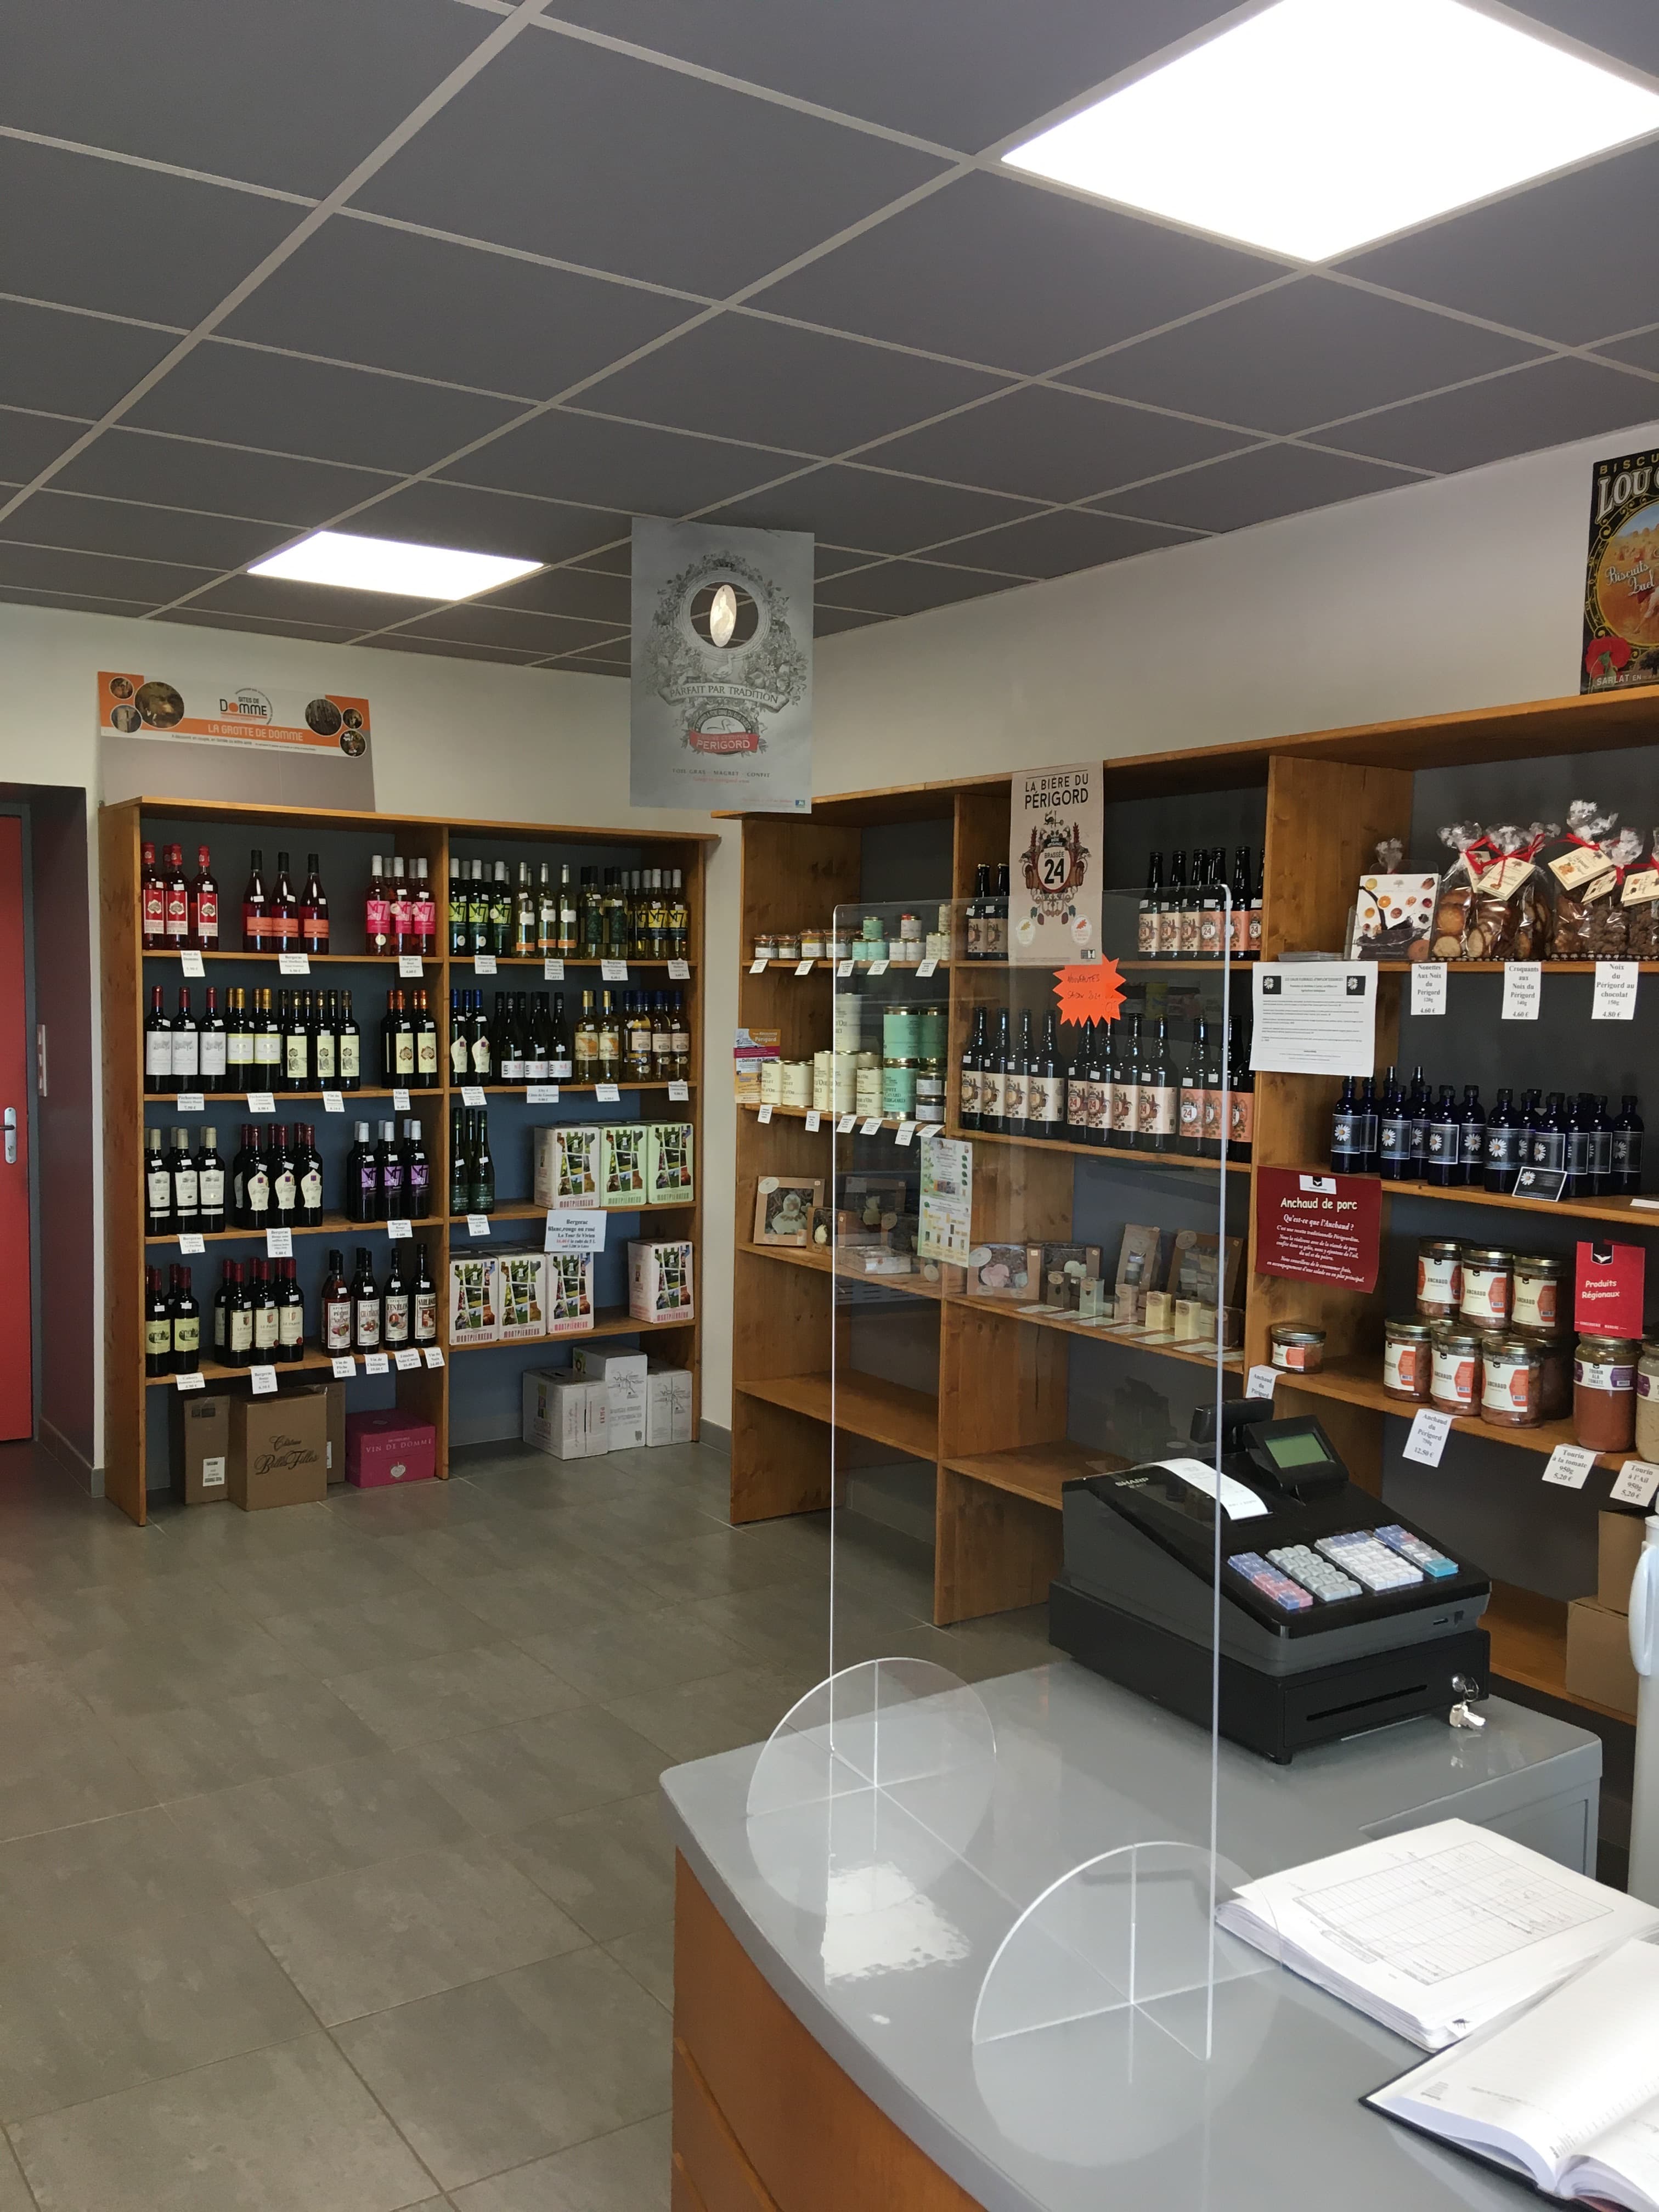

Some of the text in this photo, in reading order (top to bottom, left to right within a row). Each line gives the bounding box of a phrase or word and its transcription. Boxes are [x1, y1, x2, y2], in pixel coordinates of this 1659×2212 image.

[1595, 466, 1652, 524] LOU
[1605, 560, 1649, 585] Biscuits
[1597, 674, 1629, 686] SARLAT
[670, 685, 778, 703] PARFAIT PAR TRADITION
[220, 698, 267, 716] DOMME
[208, 724, 303, 741] LA GROTTE DE DOMME
[696, 740, 750, 750] PERIGORD
[1025, 774, 1088, 792] LA BIÈRE DU
[1025, 788, 1088, 809] PÉRIGORD
[1044, 859, 1064, 884] 24
[1183, 1109, 1192, 1119] 24
[1280, 1197, 1357, 1212] Anchaud de porc
[1284, 1214, 1308, 1224] Qu'est-ce
[1321, 1219, 1350, 1230] l'Anchaud
[1582, 1290, 1620, 1299] Régionaux
[1254, 1373, 1273, 1384] Anchaud
[1487, 1380, 1506, 1390] ANCHAUD
[1422, 1414, 1448, 1425] Anchaud
[1417, 1428, 1442, 1441] Périgord
[365, 1445, 382, 1453] VIN
[400, 1438, 432, 1449] DOMME
[1562, 1449, 1584, 1460] Tourin
[1565, 1458, 1587, 1469] tomate
[1559, 1465, 1574, 1475] 950g
[1632, 1465, 1654, 1476] Tourin
[1115, 1477, 1149, 1486] SHARP
[1627, 1482, 1642, 1492] 950g
